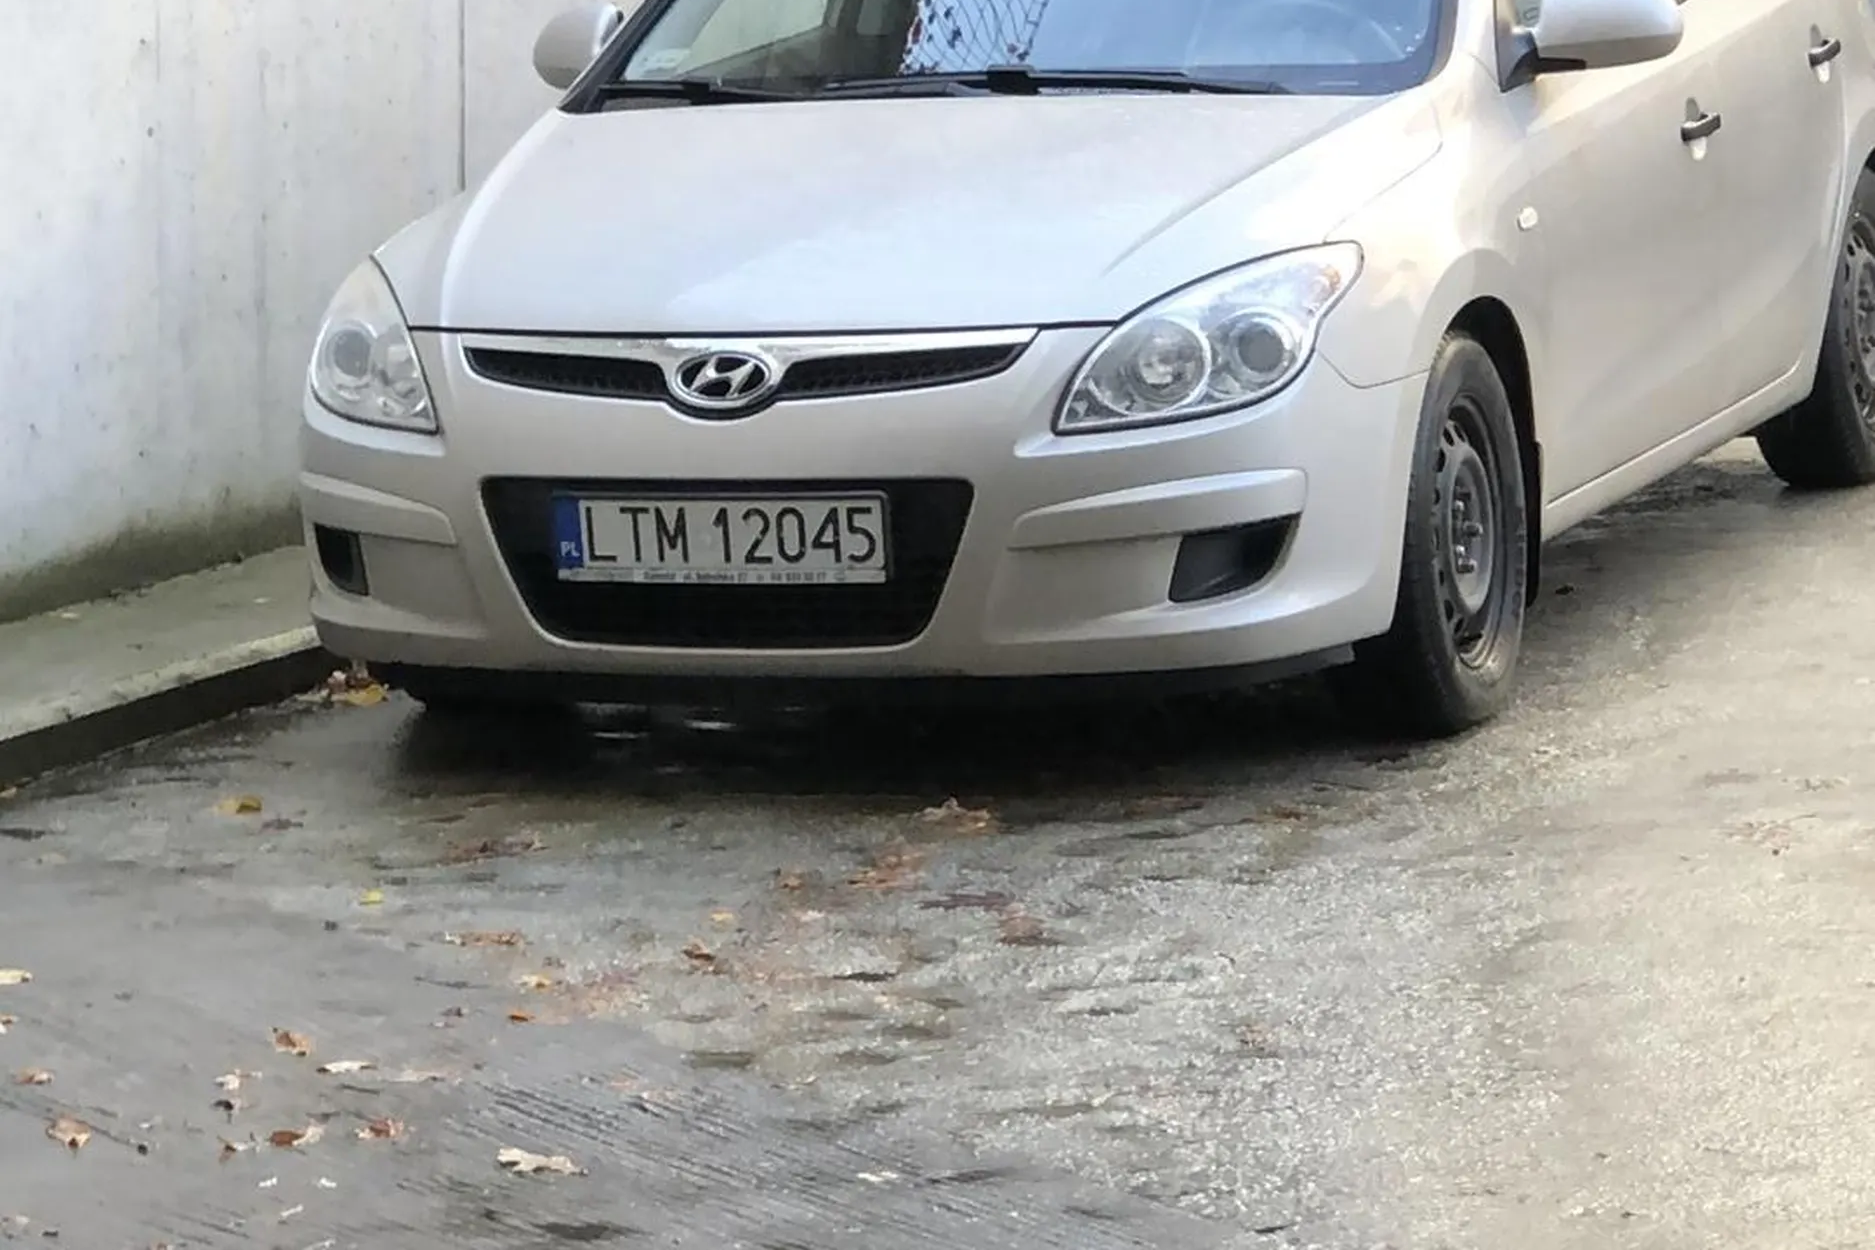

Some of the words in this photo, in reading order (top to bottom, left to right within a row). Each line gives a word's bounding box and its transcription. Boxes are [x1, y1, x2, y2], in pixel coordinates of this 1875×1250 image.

[561, 541, 580, 557] PL
[586, 506, 689, 563] LTM
[712, 506, 877, 564] 12045
